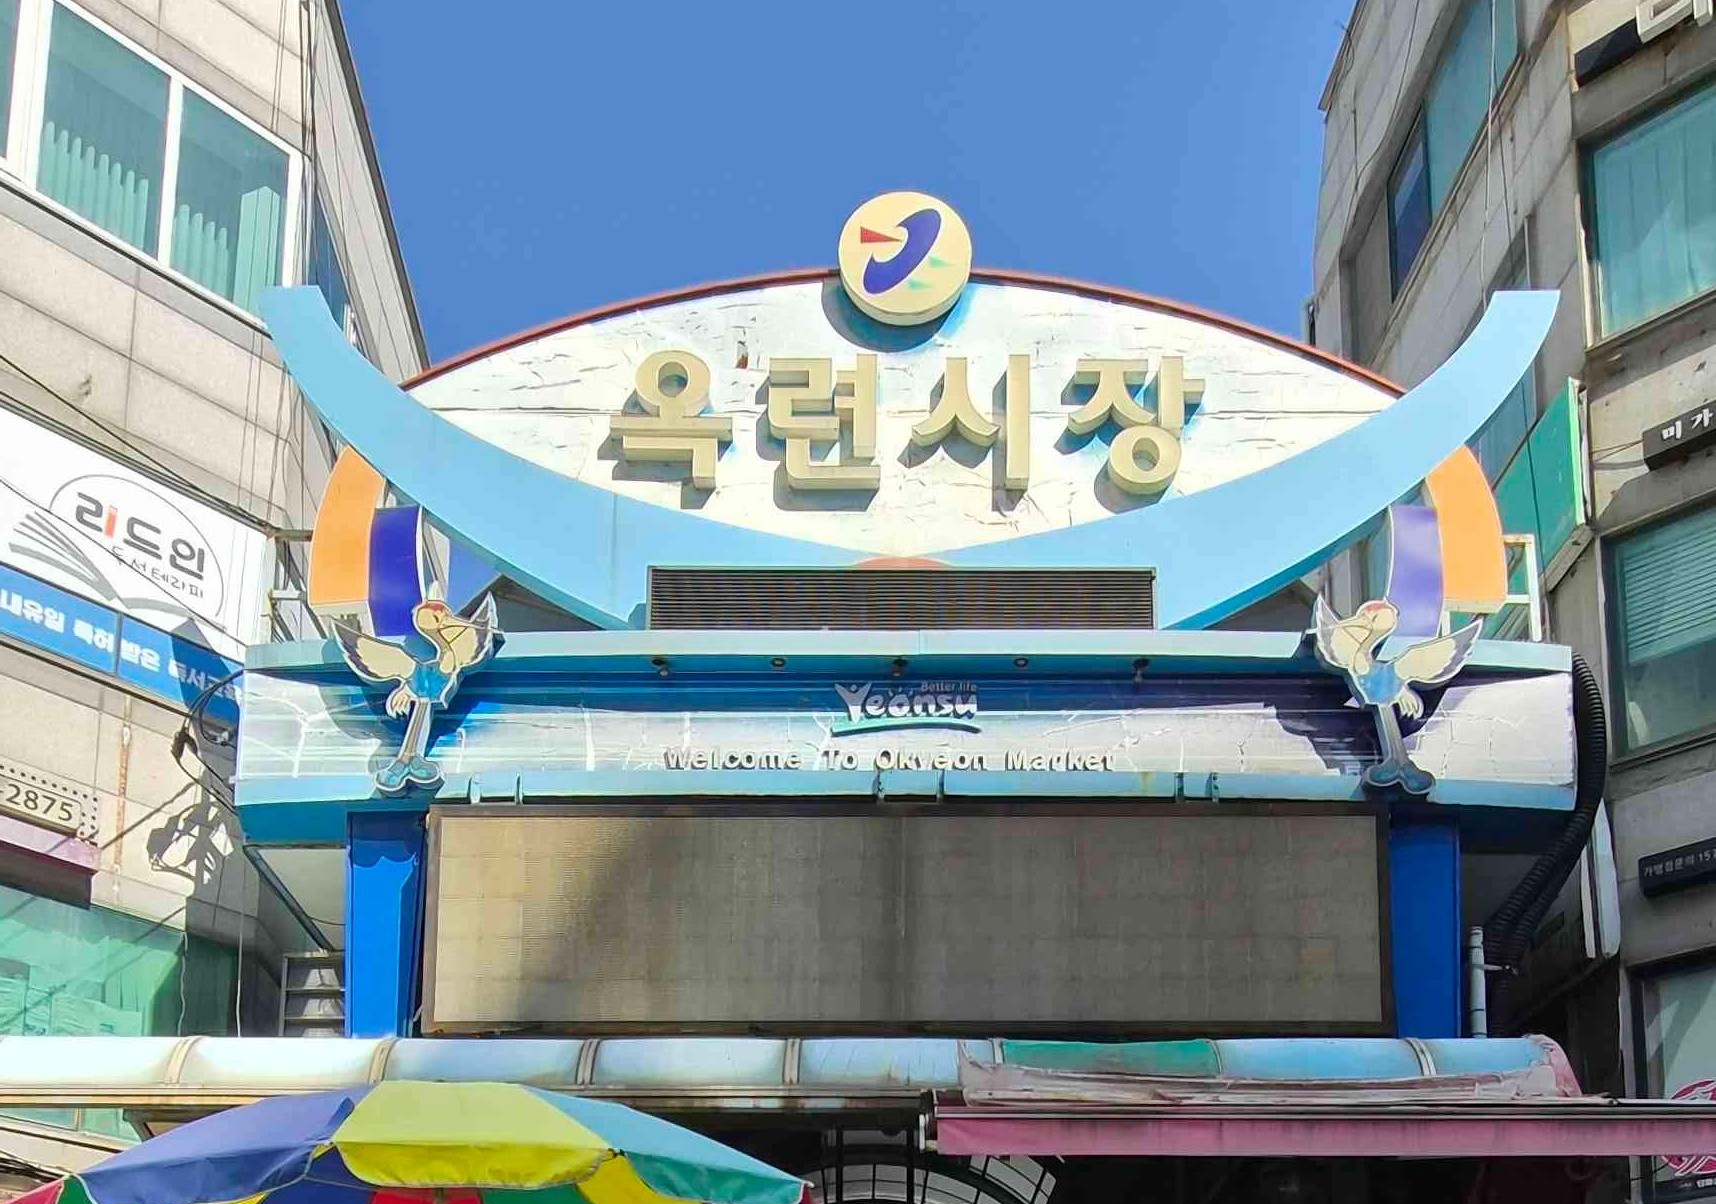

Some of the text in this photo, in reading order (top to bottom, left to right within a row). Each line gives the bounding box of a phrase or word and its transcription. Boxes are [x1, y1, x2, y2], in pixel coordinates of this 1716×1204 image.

[608, 349, 1206, 495] 옥련시장
[75, 491, 206, 581] 리드인
[834, 681, 978, 724] Yeonsu
[920, 681, 956, 693] Better
[663, 747, 801, 771] Welcome
[820, 749, 858, 771] To
[1005, 748, 1116, 773] Market
